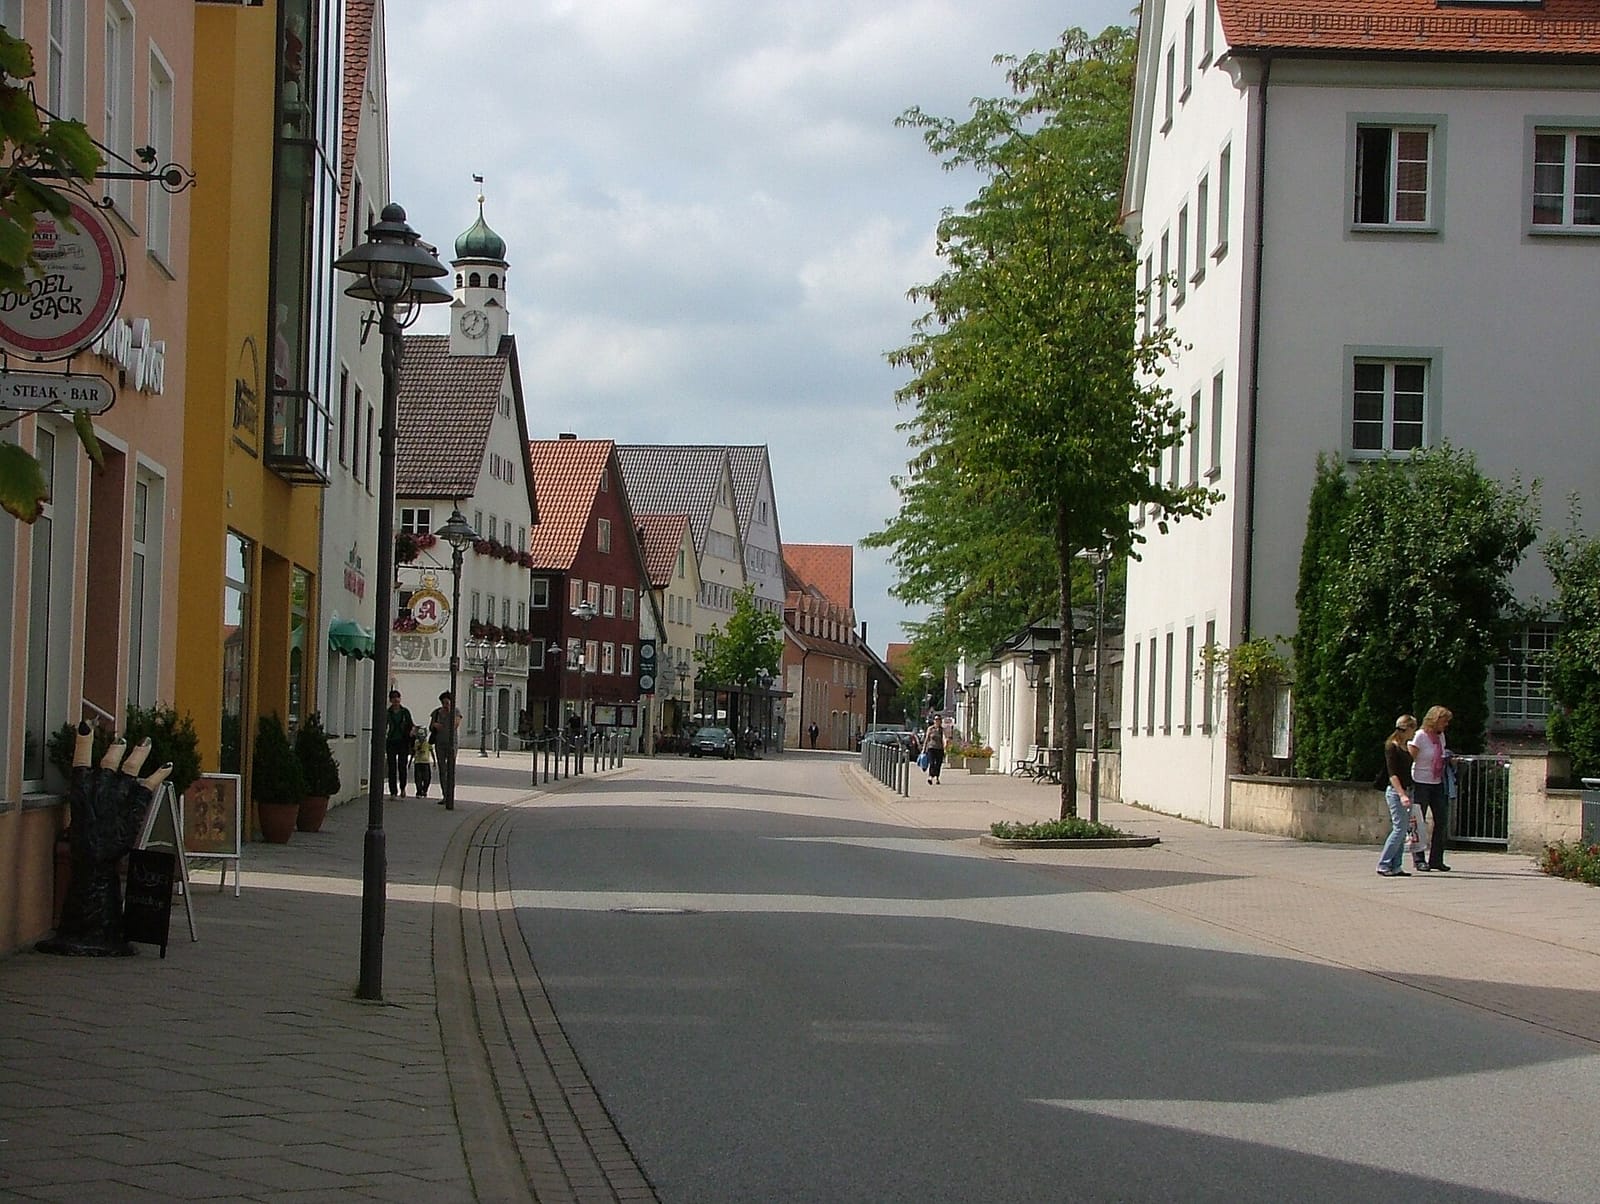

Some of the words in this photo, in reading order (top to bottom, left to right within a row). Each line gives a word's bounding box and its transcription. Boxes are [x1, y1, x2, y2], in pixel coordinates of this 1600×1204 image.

[0, 274, 73, 312] DUDEL
[30, 296, 83, 320] SACK
[12, 384, 58, 399] STEAK
[70, 388, 99, 401] BAR
[418, 599, 437, 620] A
